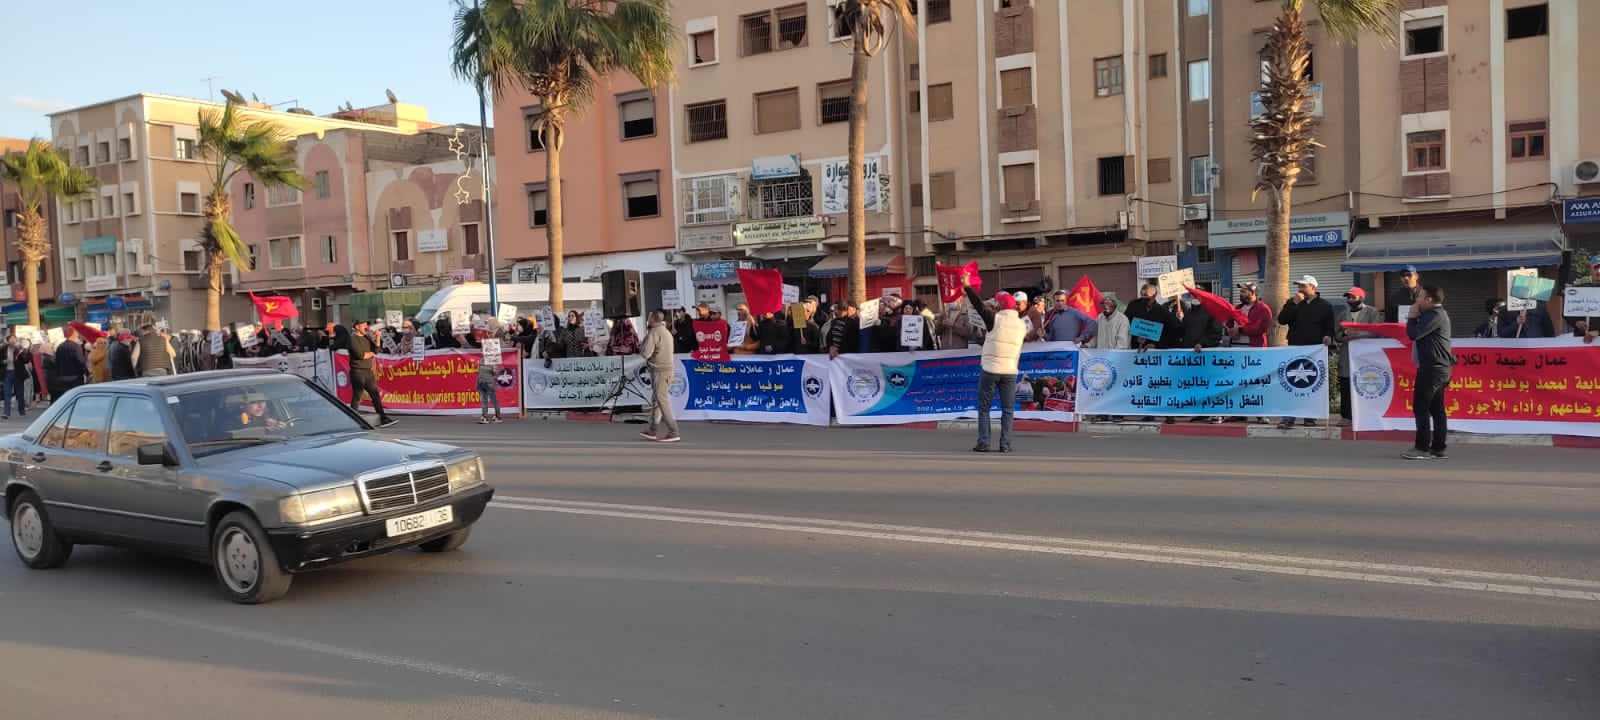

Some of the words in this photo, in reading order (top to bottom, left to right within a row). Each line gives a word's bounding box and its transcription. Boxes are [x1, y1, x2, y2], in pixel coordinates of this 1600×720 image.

[1291, 230, 1323, 243] Allianz
[1133, 355, 1162, 368] التابعة
[1212, 355, 1235, 369] ضيعة
[1240, 355, 1262, 369] عمال
[1496, 352, 1526, 370] ضيعة
[1535, 353, 1567, 369] عمال
[776, 364, 795, 376] عمال
[1122, 375, 1143, 389] قانون
[1177, 375, 1210, 389] يطالبون
[1447, 376, 1482, 392] يطالبو
[1536, 378, 1567, 390] لمحمد
[457, 389, 481, 407] agrico
[1130, 394, 1162, 409] النقابية
[1166, 396, 1197, 409] الحريات
[1240, 394, 1264, 409] الشغل
